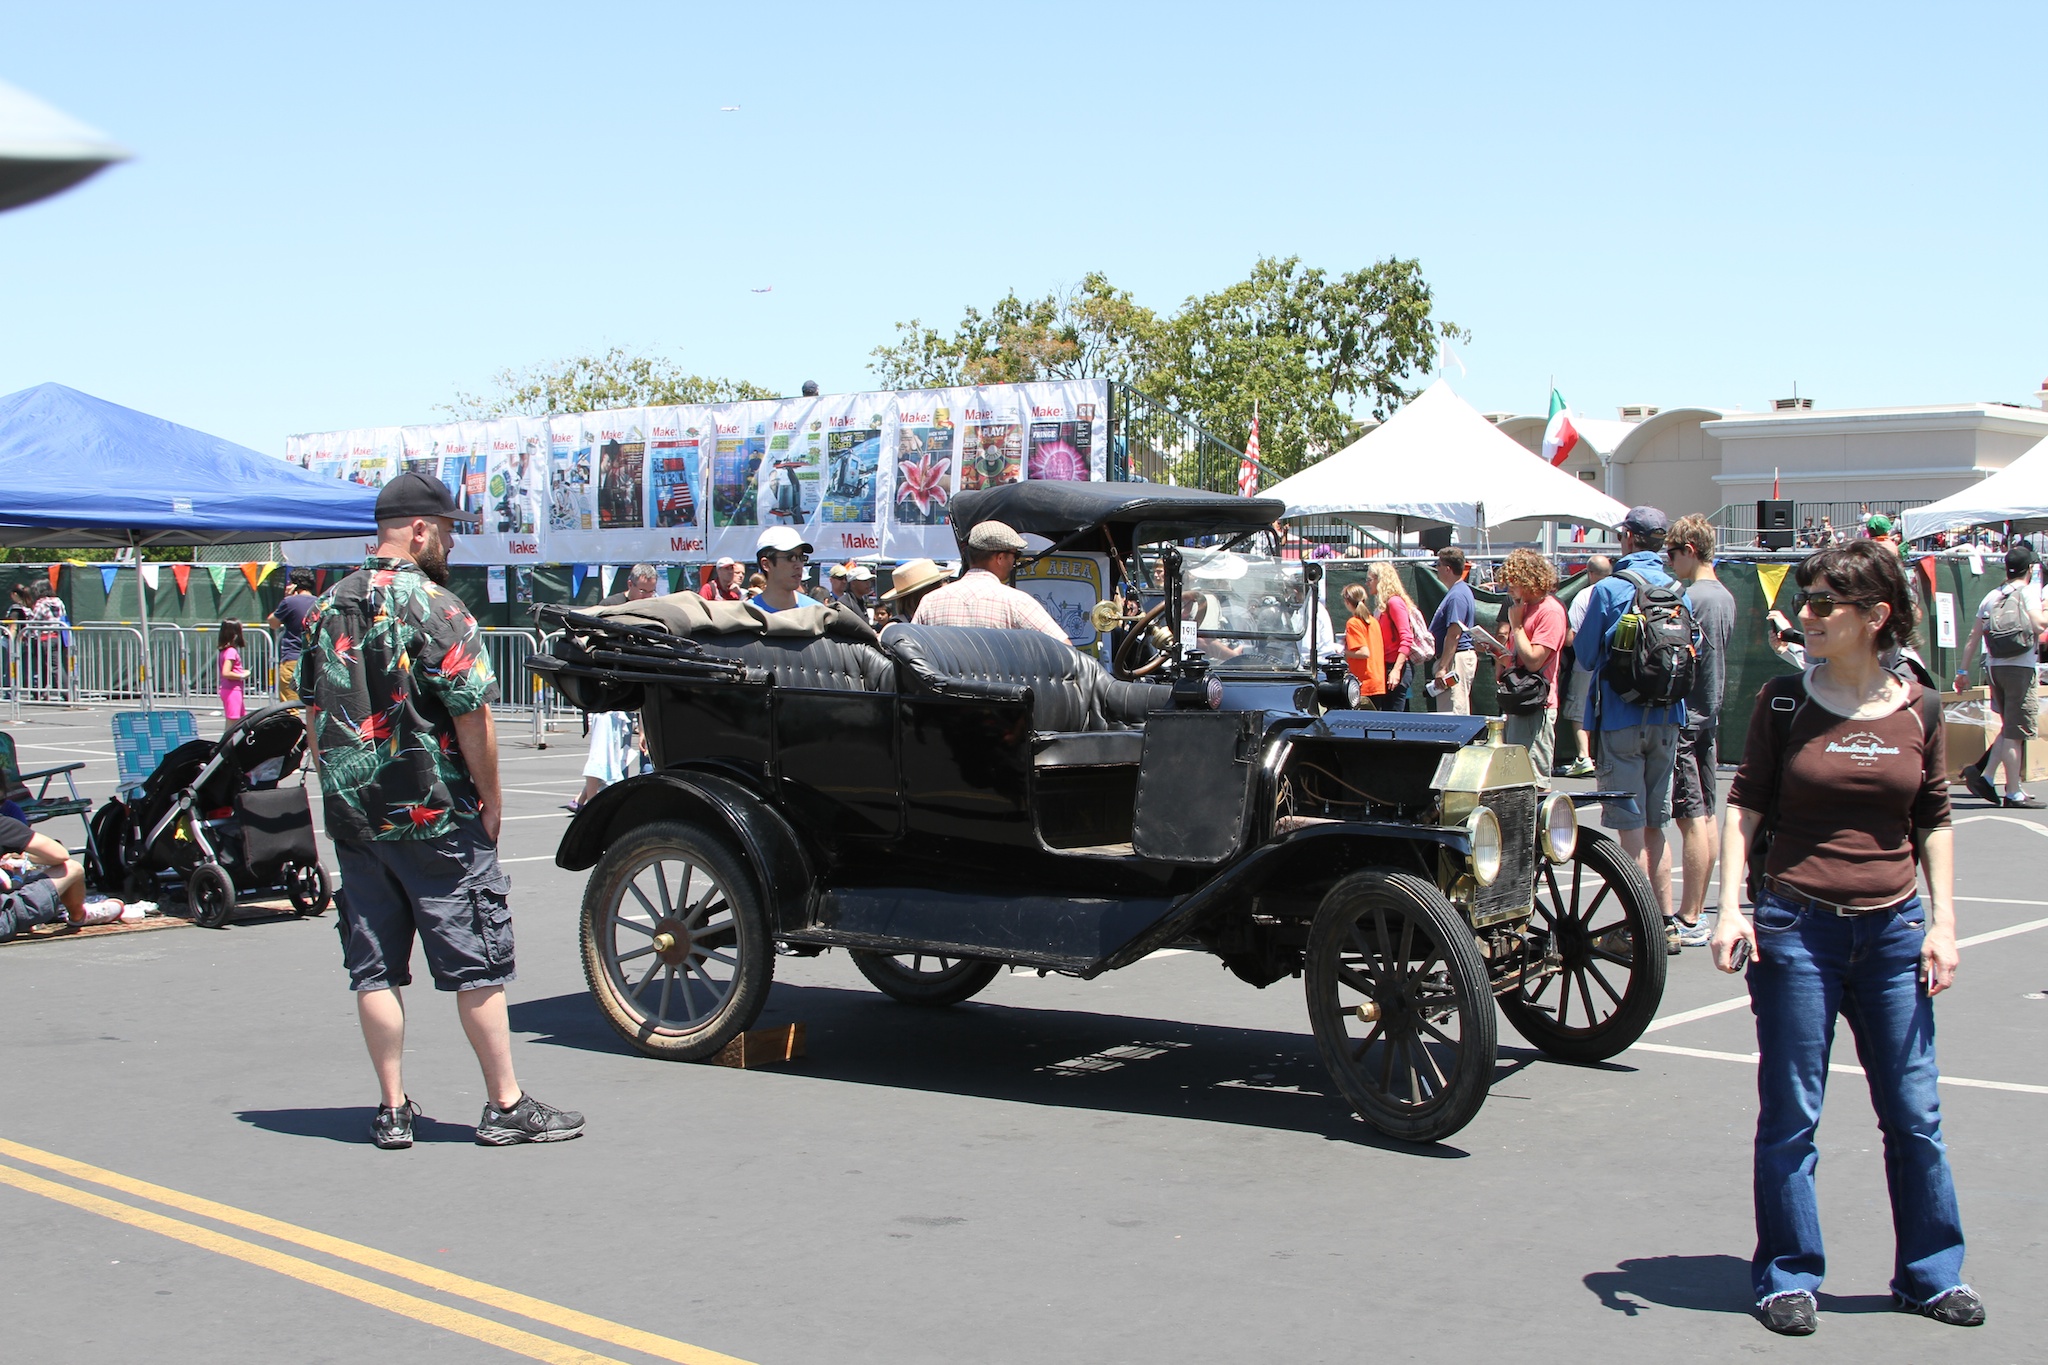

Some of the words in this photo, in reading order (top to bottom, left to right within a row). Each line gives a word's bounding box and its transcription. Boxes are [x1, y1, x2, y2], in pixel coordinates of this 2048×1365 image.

[900, 412, 930, 423] Make:
[965, 409, 993, 420] Make:
[1031, 406, 1063, 418] Make:
[774, 420, 797, 431] Make:
[829, 416, 856, 427] Make:
[601, 429, 624, 439] Make:
[652, 426, 677, 437] Make:
[715, 424, 740, 434] Make:
[982, 426, 1004, 437] PLAY!
[551, 433, 573, 443] Make:
[829, 434, 840, 442] 10
[446, 443, 468, 453] Make:
[493, 440, 517, 450] Make:
[670, 537, 704, 551] Make:
[841, 533, 879, 548] Make:
[509, 541, 538, 554] Make:
[1046, 560, 1093, 579] AREA
[1182, 626, 1196, 636] 1915
